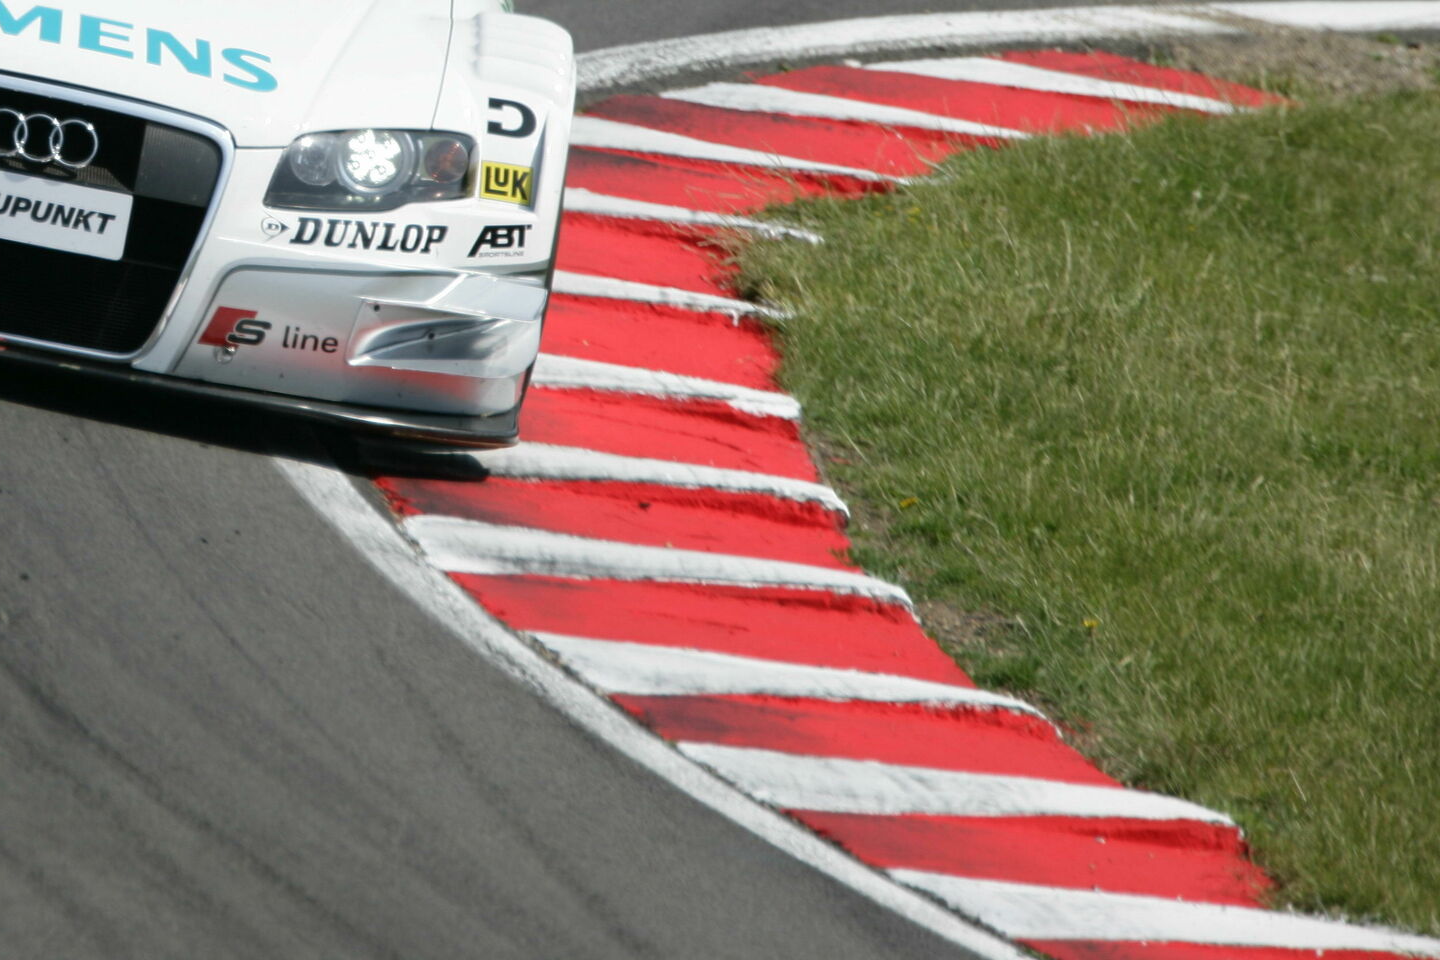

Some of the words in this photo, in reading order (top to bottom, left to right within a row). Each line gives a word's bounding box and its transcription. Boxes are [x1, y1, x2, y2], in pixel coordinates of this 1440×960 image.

[289, 216, 449, 255] DUNLOP
[467, 224, 533, 258] ABT
[227, 318, 272, 345] S
[281, 325, 339, 354] line
